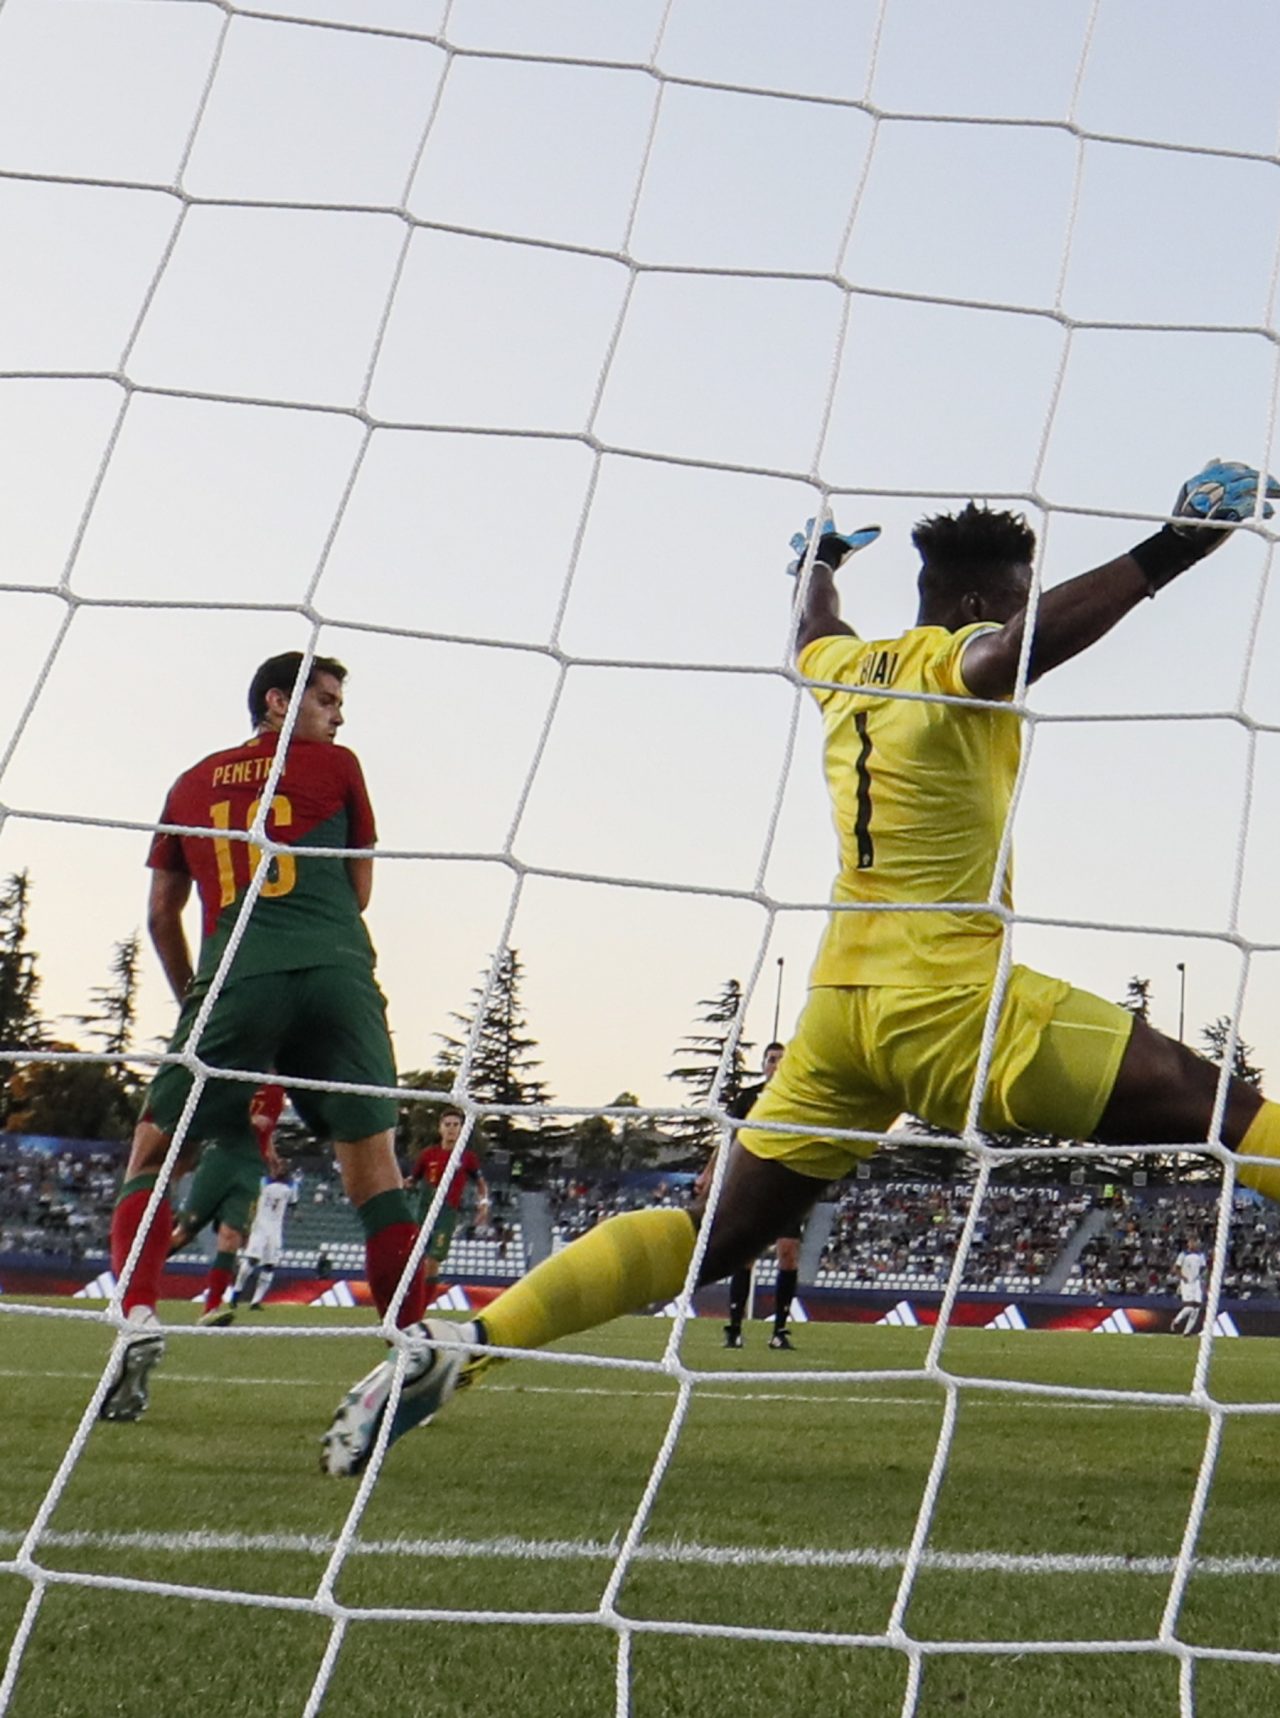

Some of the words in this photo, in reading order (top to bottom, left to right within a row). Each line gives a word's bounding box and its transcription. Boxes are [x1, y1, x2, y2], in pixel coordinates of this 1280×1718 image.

[212, 757, 286, 788] PENETR
[854, 711, 873, 868] 1
[209, 796, 296, 907] 16
